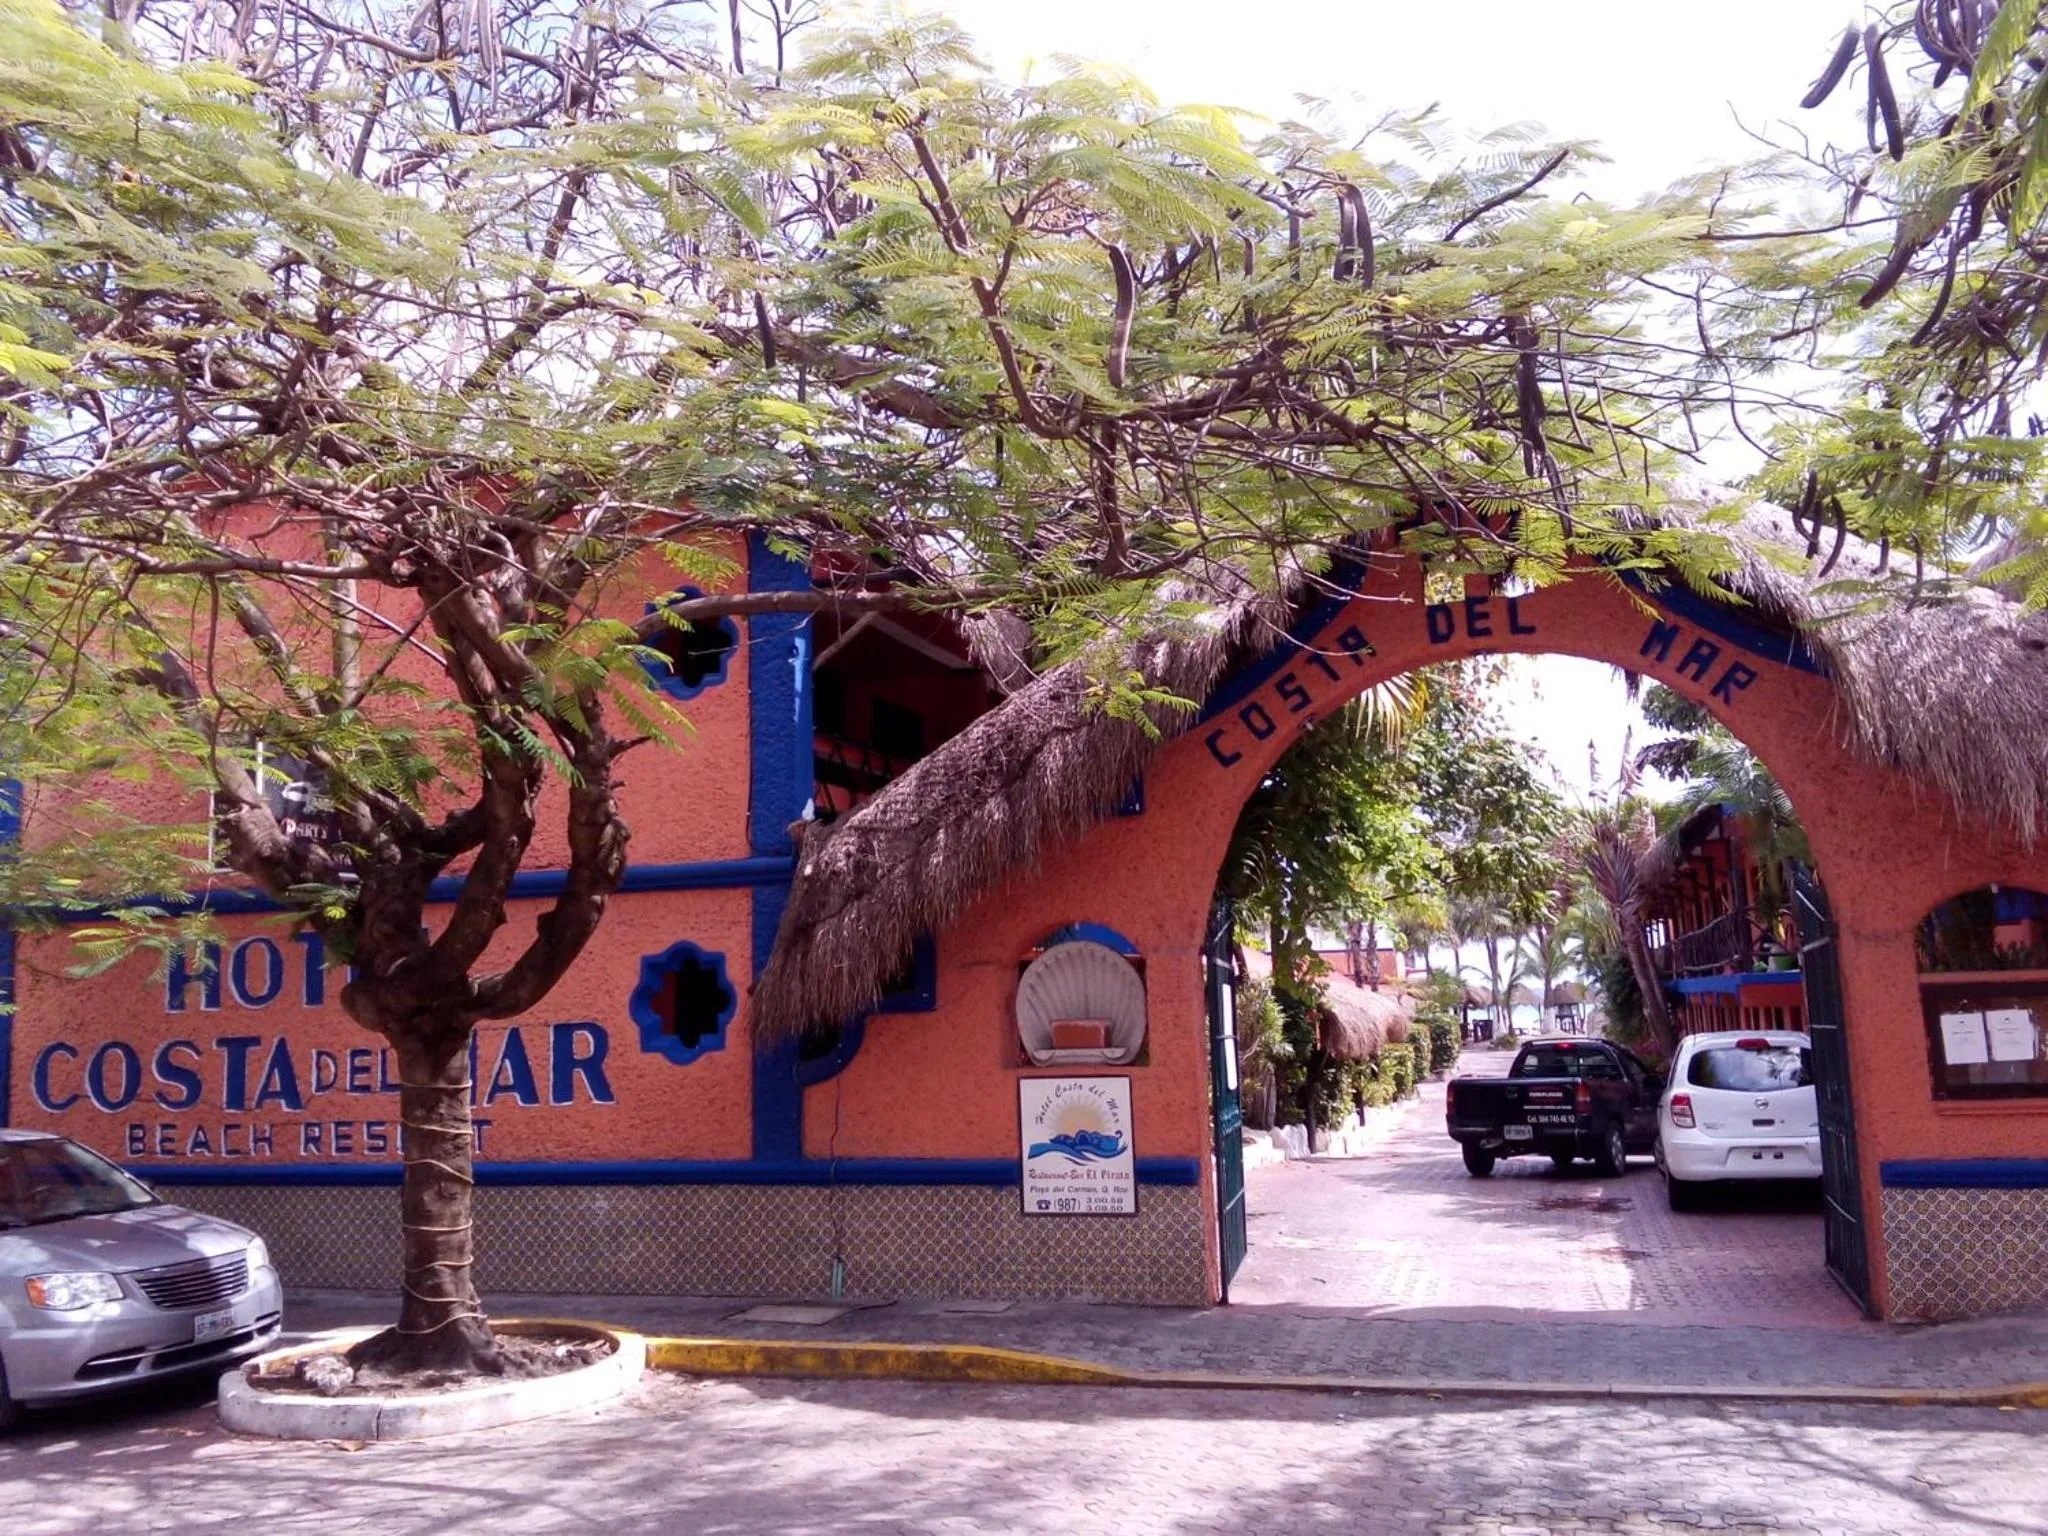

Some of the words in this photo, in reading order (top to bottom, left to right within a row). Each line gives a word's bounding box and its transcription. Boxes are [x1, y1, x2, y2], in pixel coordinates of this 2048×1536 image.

[1205, 626, 1377, 768] COSTA
[1426, 596, 1537, 645] DEL
[1639, 620, 1758, 705] MAR
[33, 1035, 305, 1112] COSTA
[311, 1046, 401, 1095] DEL
[469, 1020, 616, 1108] AR
[1035, 1096, 1052, 1124] Hotel
[1055, 1082, 1083, 1098] Costa
[1088, 1083, 1105, 1098] del
[1106, 1097, 1120, 1124] Mar
[126, 1123, 274, 1158] BEACH
[301, 1119, 493, 1158] REST
[1086, 1169, 1097, 1180] El
[1101, 1169, 1130, 1180] Pirata
[1053, 1198, 1081, 1212] (987)
